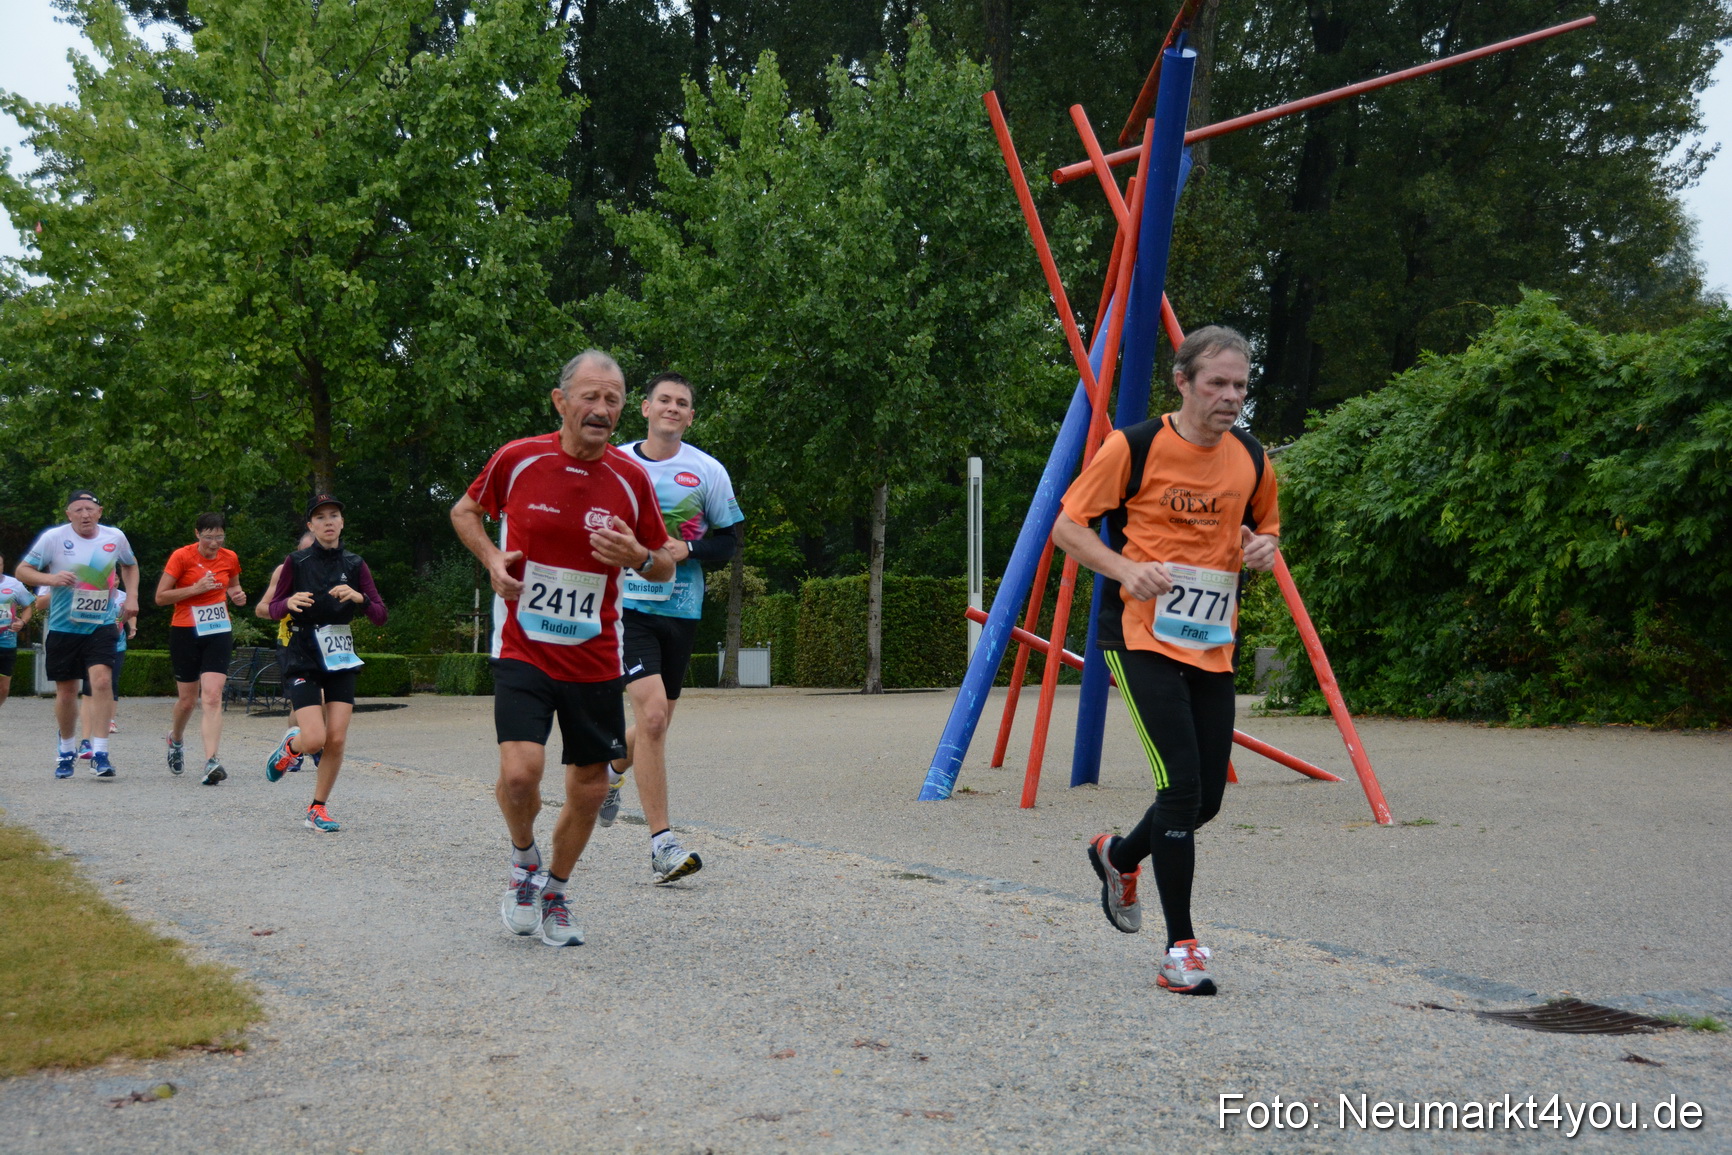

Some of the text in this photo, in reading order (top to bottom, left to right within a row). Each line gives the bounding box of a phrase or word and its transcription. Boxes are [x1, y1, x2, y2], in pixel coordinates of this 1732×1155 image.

[1170, 496, 1221, 513] OEXL
[628, 582, 664, 593] Christoph
[76, 597, 108, 611] 2202
[528, 582, 596, 619] 2414
[1166, 585, 1230, 622] 2771
[198, 606, 226, 622] 2298
[541, 619, 578, 635] Rudolf
[1180, 624, 1209, 640] Franz
